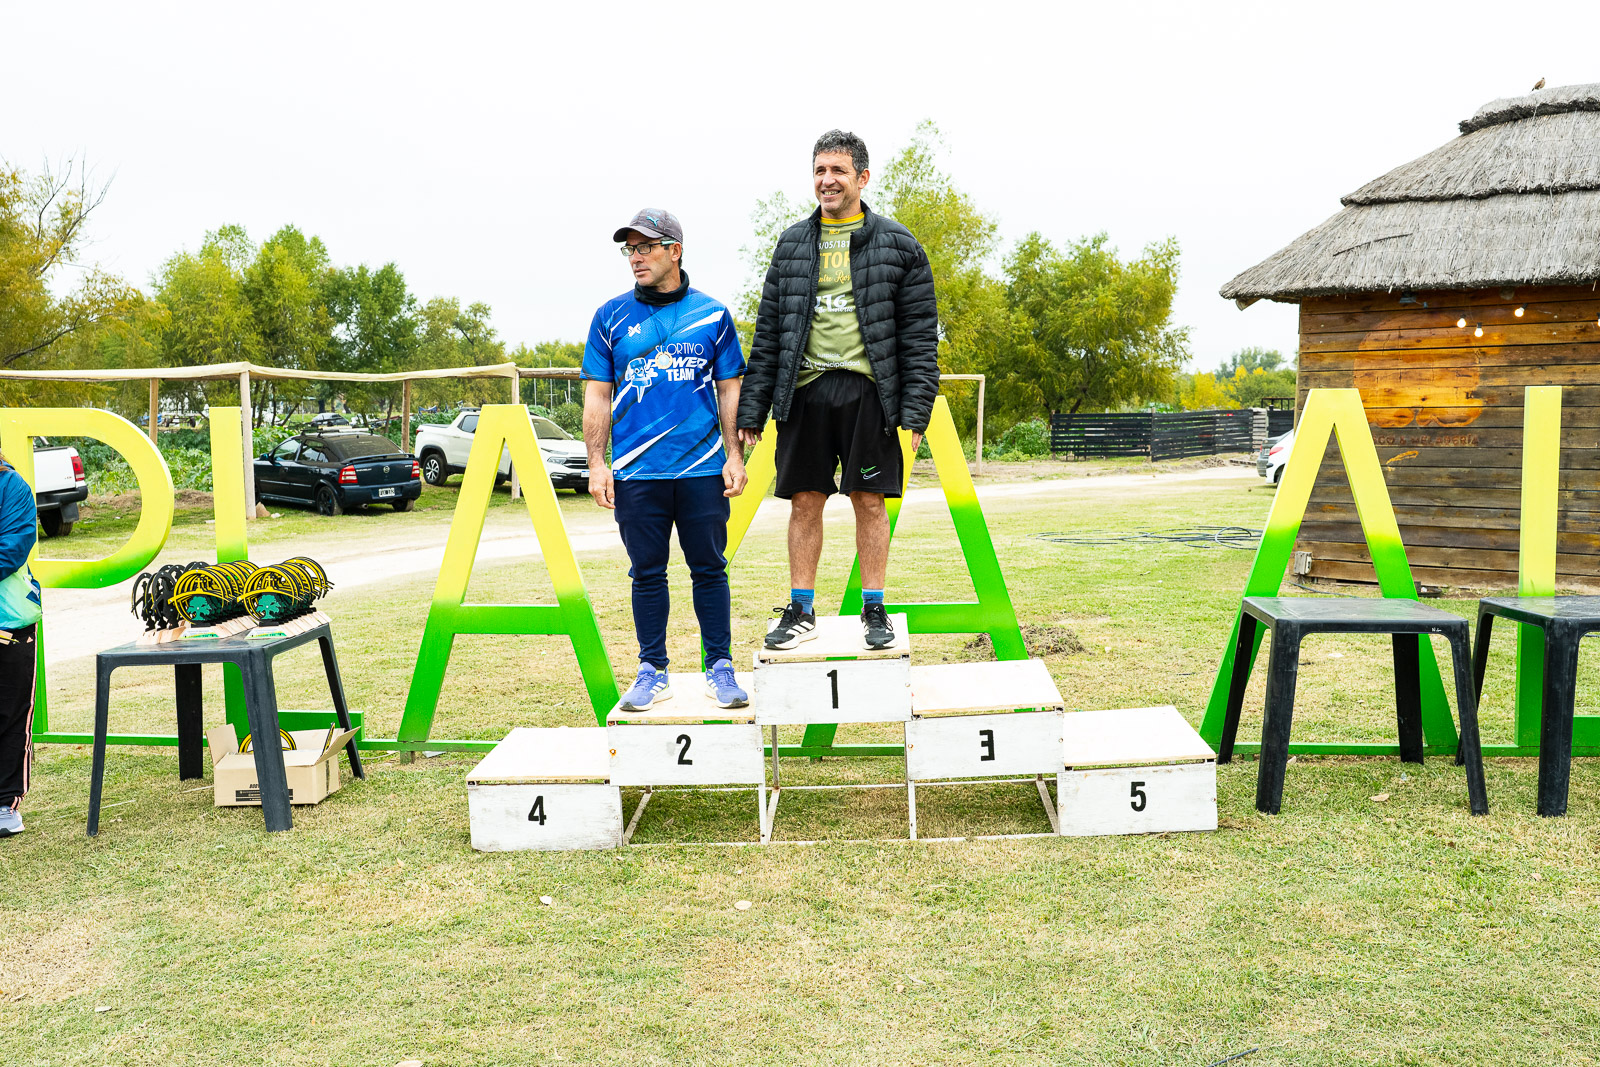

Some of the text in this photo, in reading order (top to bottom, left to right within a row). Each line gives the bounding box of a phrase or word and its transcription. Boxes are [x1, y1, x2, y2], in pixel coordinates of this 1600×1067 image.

[645, 356, 708, 371] PWER
[666, 368, 695, 381] TEAM
[826, 669, 839, 709] 1
[675, 733, 693, 766] 2
[979, 729, 995, 762] 3
[527, 795, 547, 826] 4
[1130, 781, 1147, 812] 5
